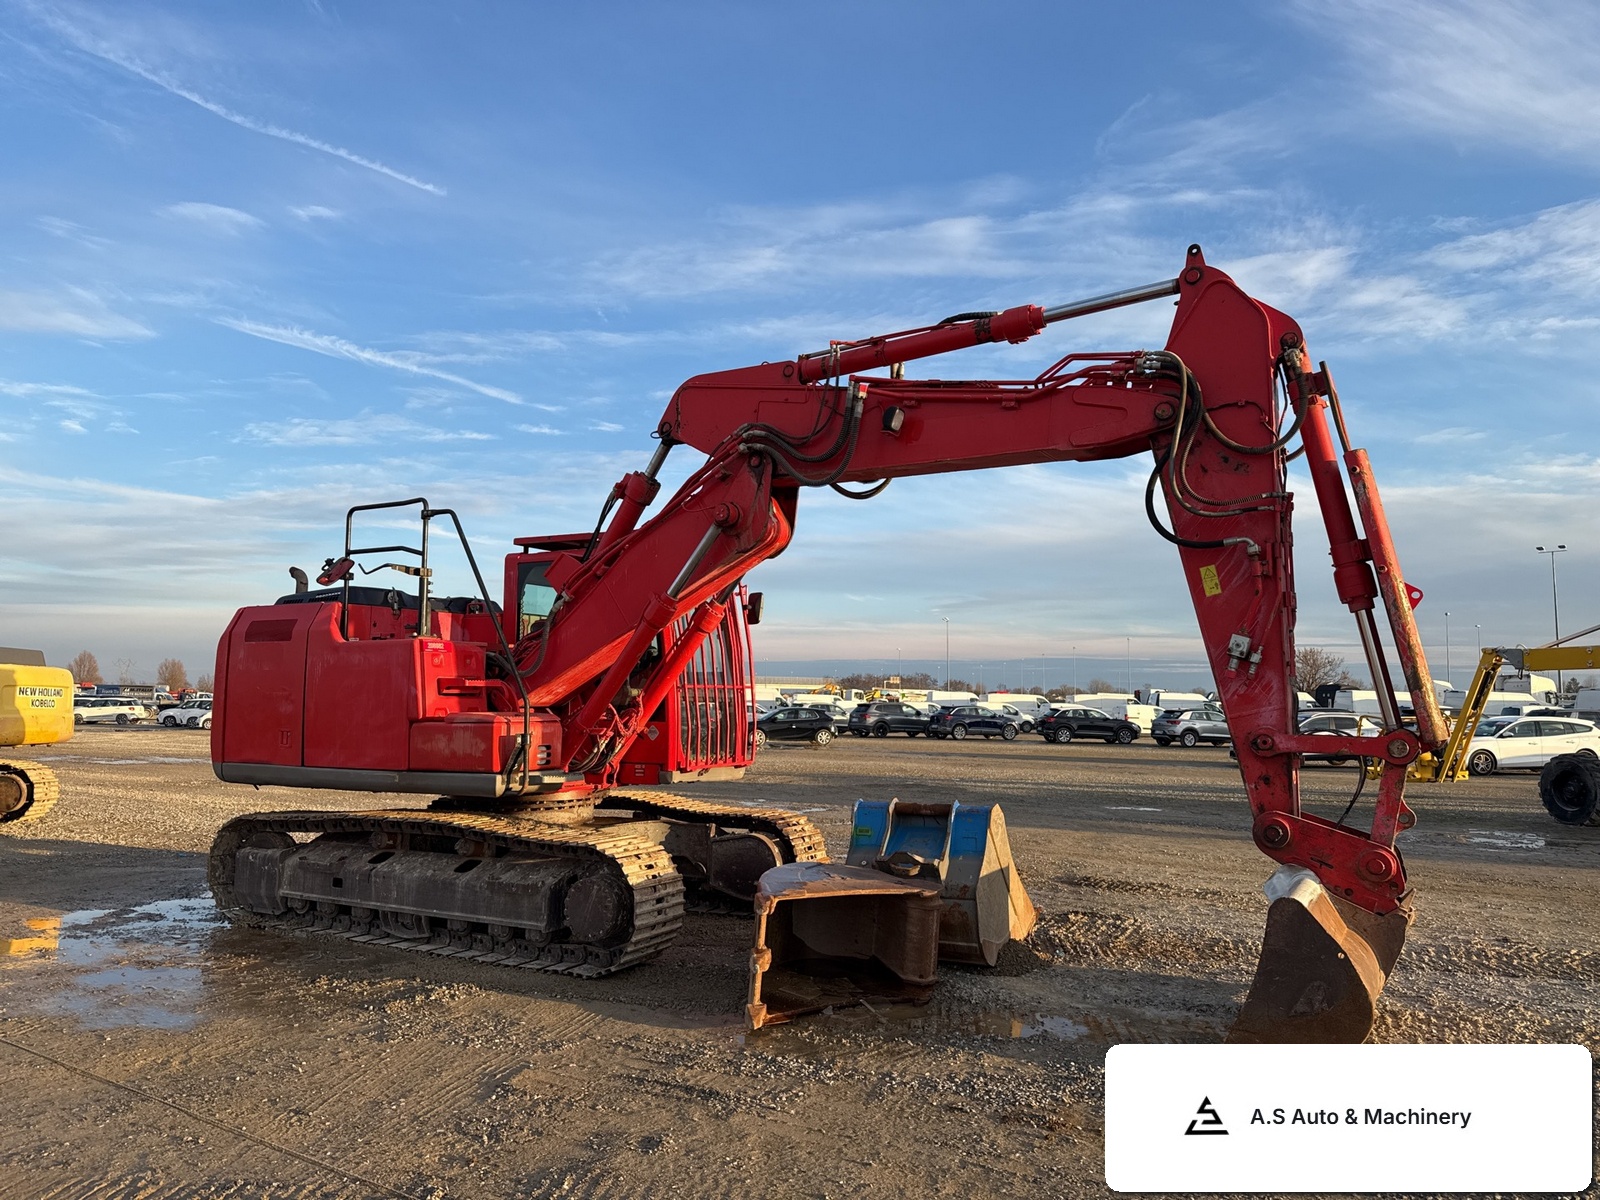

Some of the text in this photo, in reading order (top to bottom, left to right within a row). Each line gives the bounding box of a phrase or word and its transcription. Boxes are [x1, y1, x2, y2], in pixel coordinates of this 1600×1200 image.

[18, 687, 63, 697] NEW HOLLAND
[31, 699, 55, 708] KOBELCO
